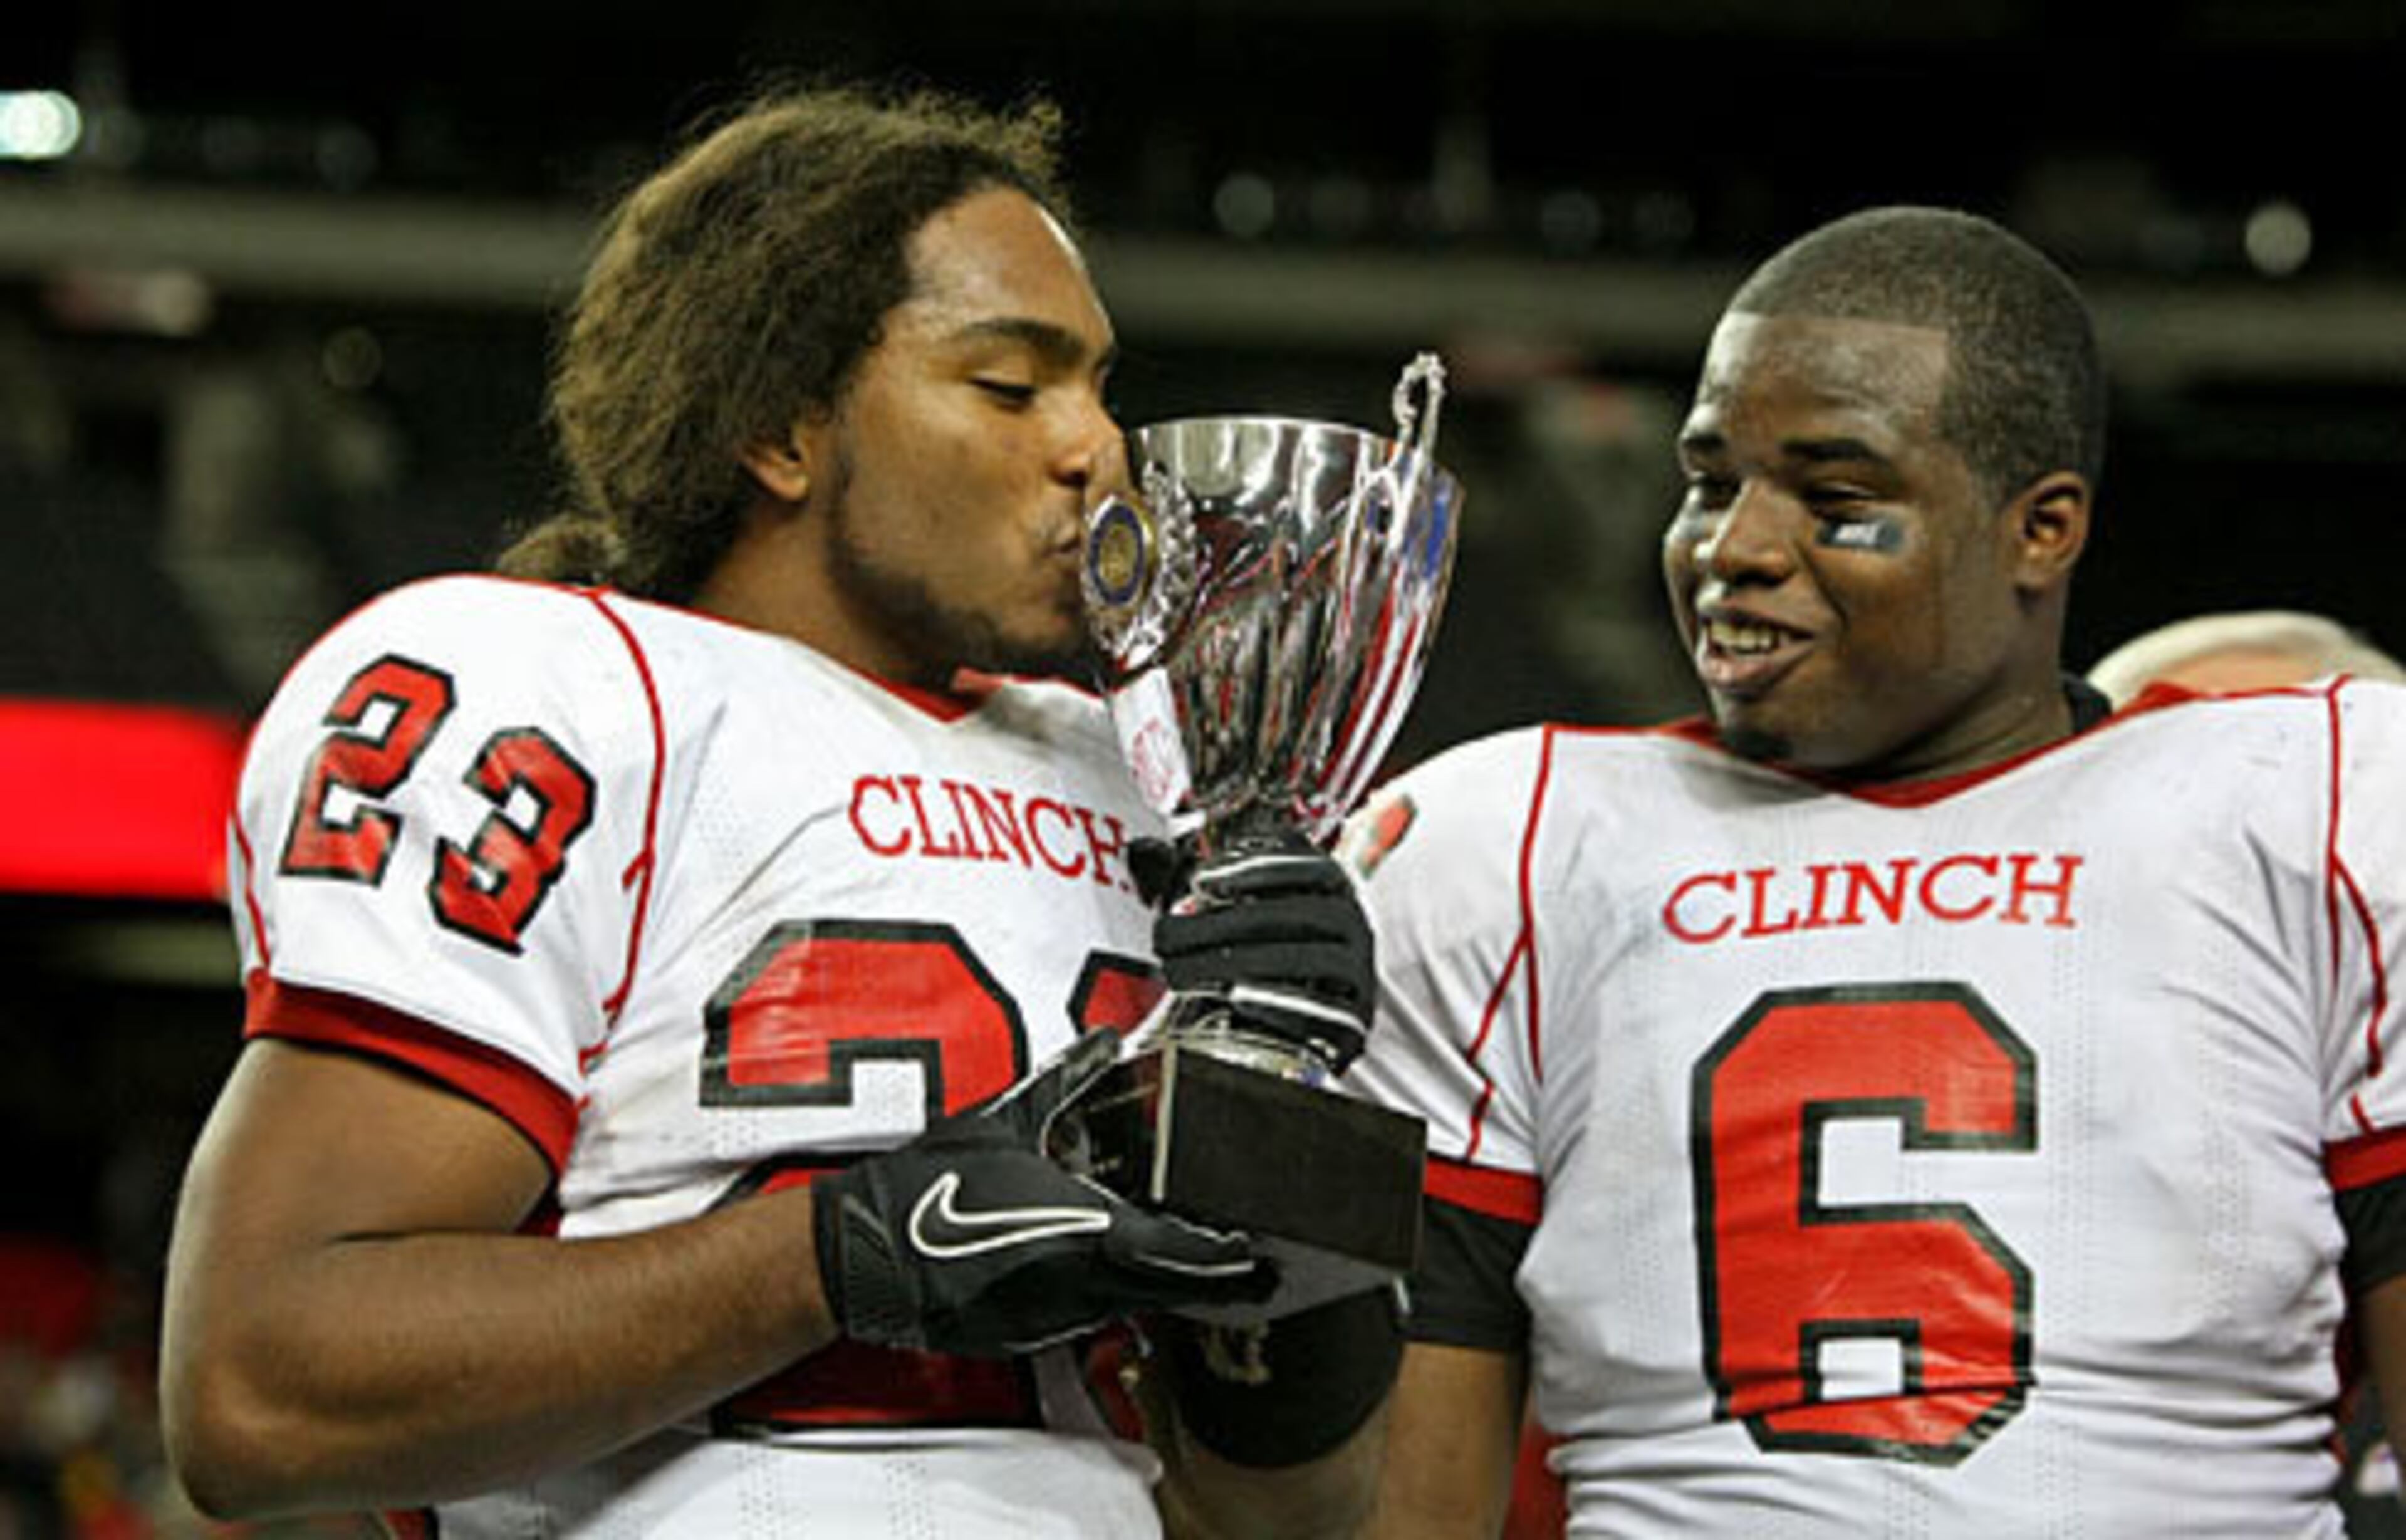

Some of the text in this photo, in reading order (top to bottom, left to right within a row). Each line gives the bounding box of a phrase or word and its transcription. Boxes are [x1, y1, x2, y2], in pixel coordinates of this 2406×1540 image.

[276, 653, 598, 957] 23
[848, 774, 1130, 892] CLINCH
[1660, 854, 2084, 944] CLINCH
[1689, 981, 2040, 1467] 6
